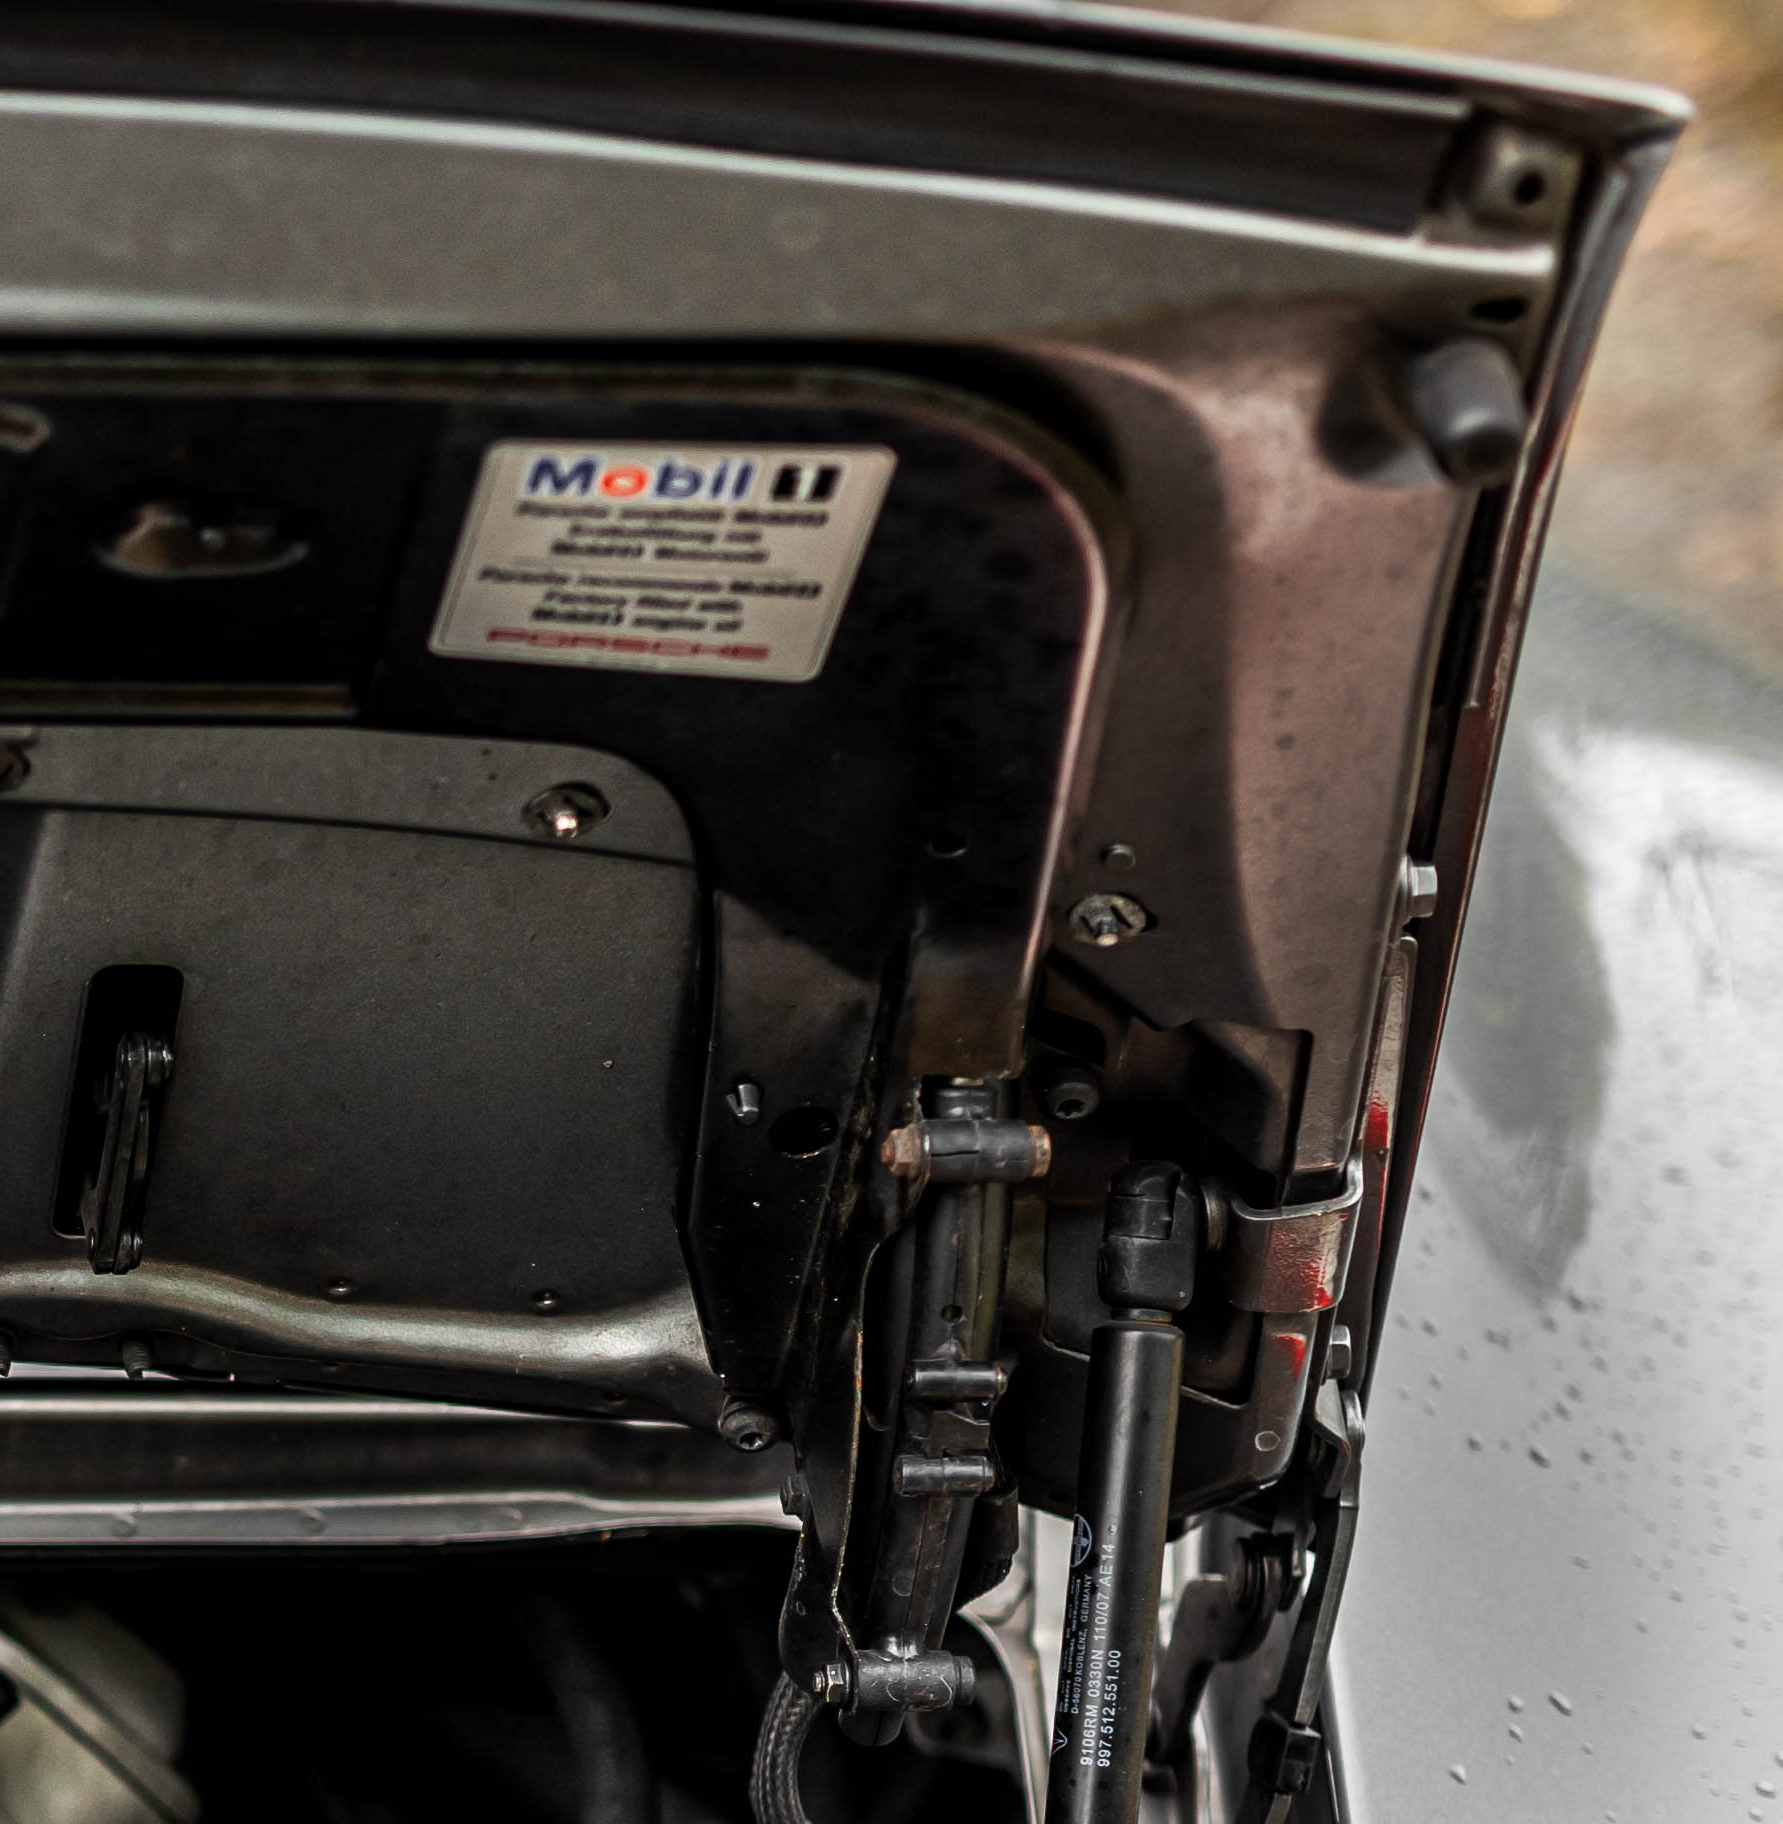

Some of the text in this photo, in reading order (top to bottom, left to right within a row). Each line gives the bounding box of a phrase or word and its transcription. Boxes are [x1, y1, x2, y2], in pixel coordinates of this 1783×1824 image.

[527, 456, 755, 499] Mobil
[487, 628, 770, 661] PORSCHE
[1080, 1574, 1092, 1623] GERMANY
[1093, 1592, 1111, 1641] 110/07
[1074, 1627, 1088, 1676] KOBLENZ,
[1087, 1649, 1104, 1698] 0330N
[1096, 1649, 1122, 1767] 997.512.551.00
[1080, 1705, 1099, 1766] 9106RM
